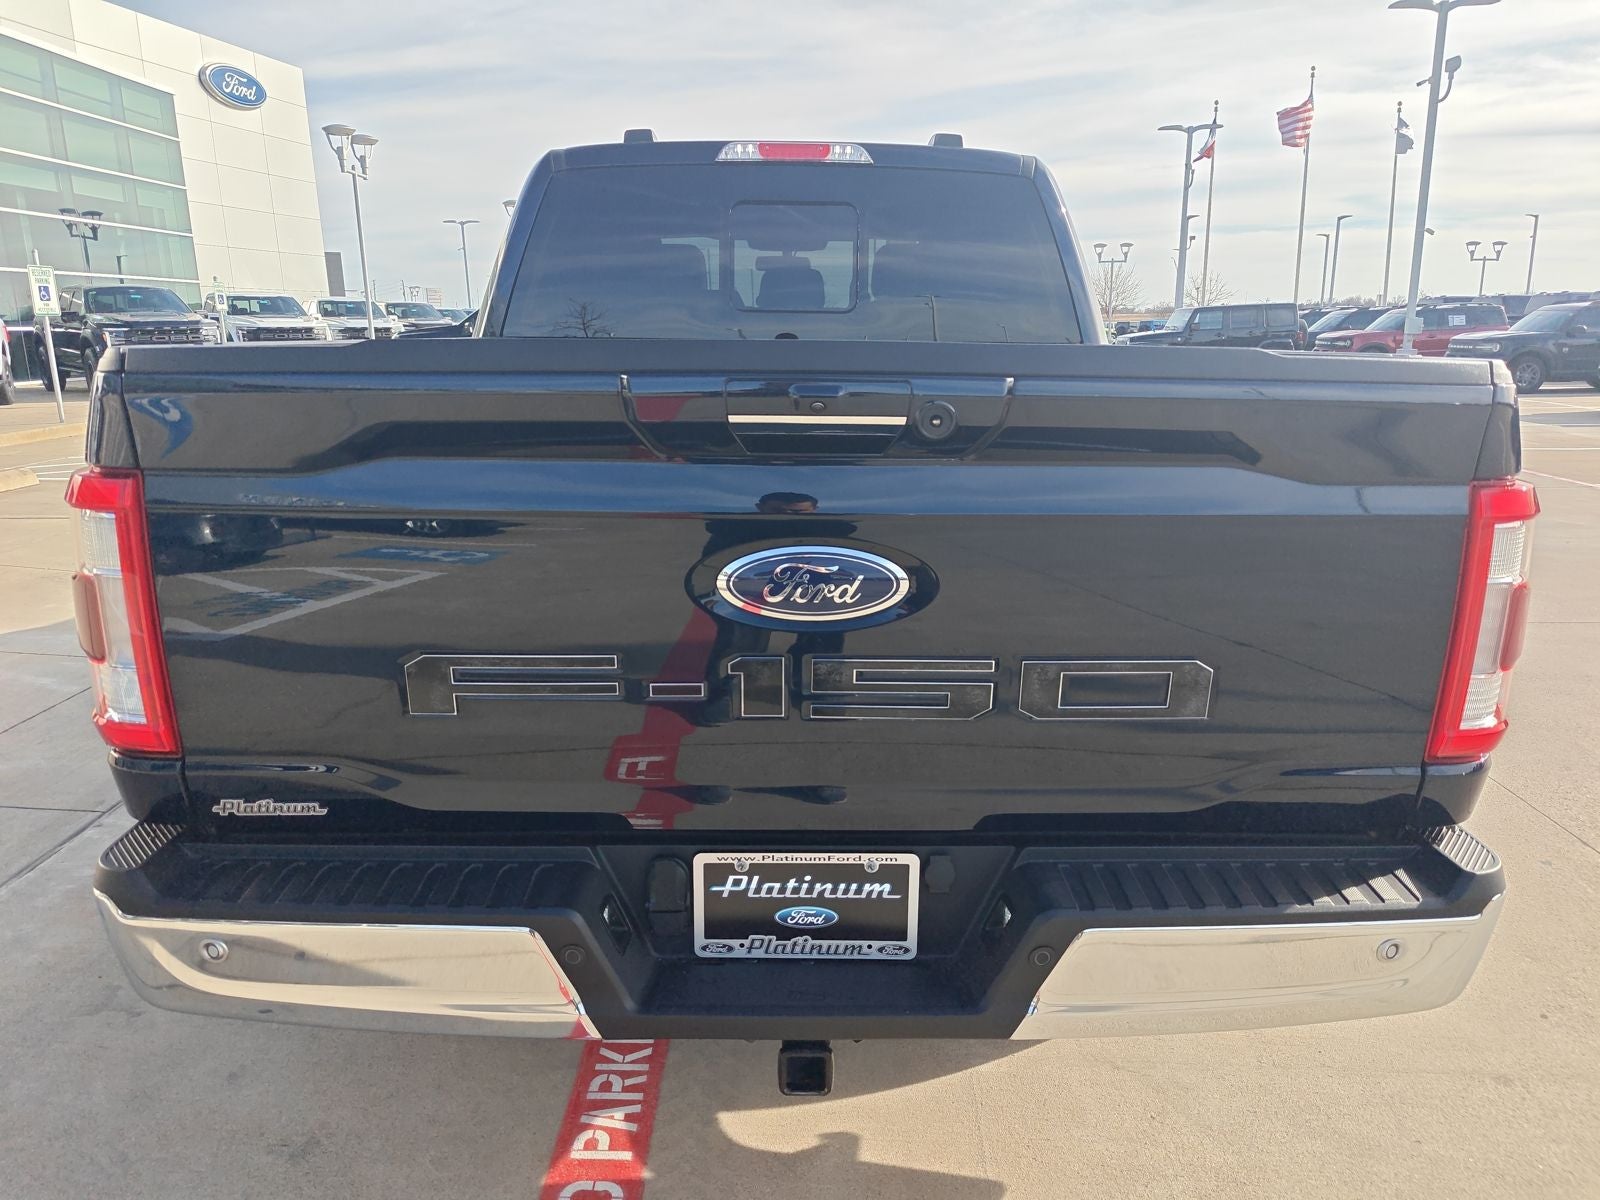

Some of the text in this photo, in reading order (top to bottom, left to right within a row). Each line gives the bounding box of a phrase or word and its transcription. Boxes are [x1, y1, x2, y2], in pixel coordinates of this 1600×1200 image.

[222, 72, 257, 101] Ford
[762, 562, 865, 604] Ford
[404, 654, 1214, 721] F-150
[211, 799, 328, 816] Platinum
[716, 855, 899, 863] www.PlatinumFord.com
[708, 875, 902, 899] Platinum
[787, 909, 826, 925] Ford
[706, 936, 906, 956] Ford Platinum Ford
